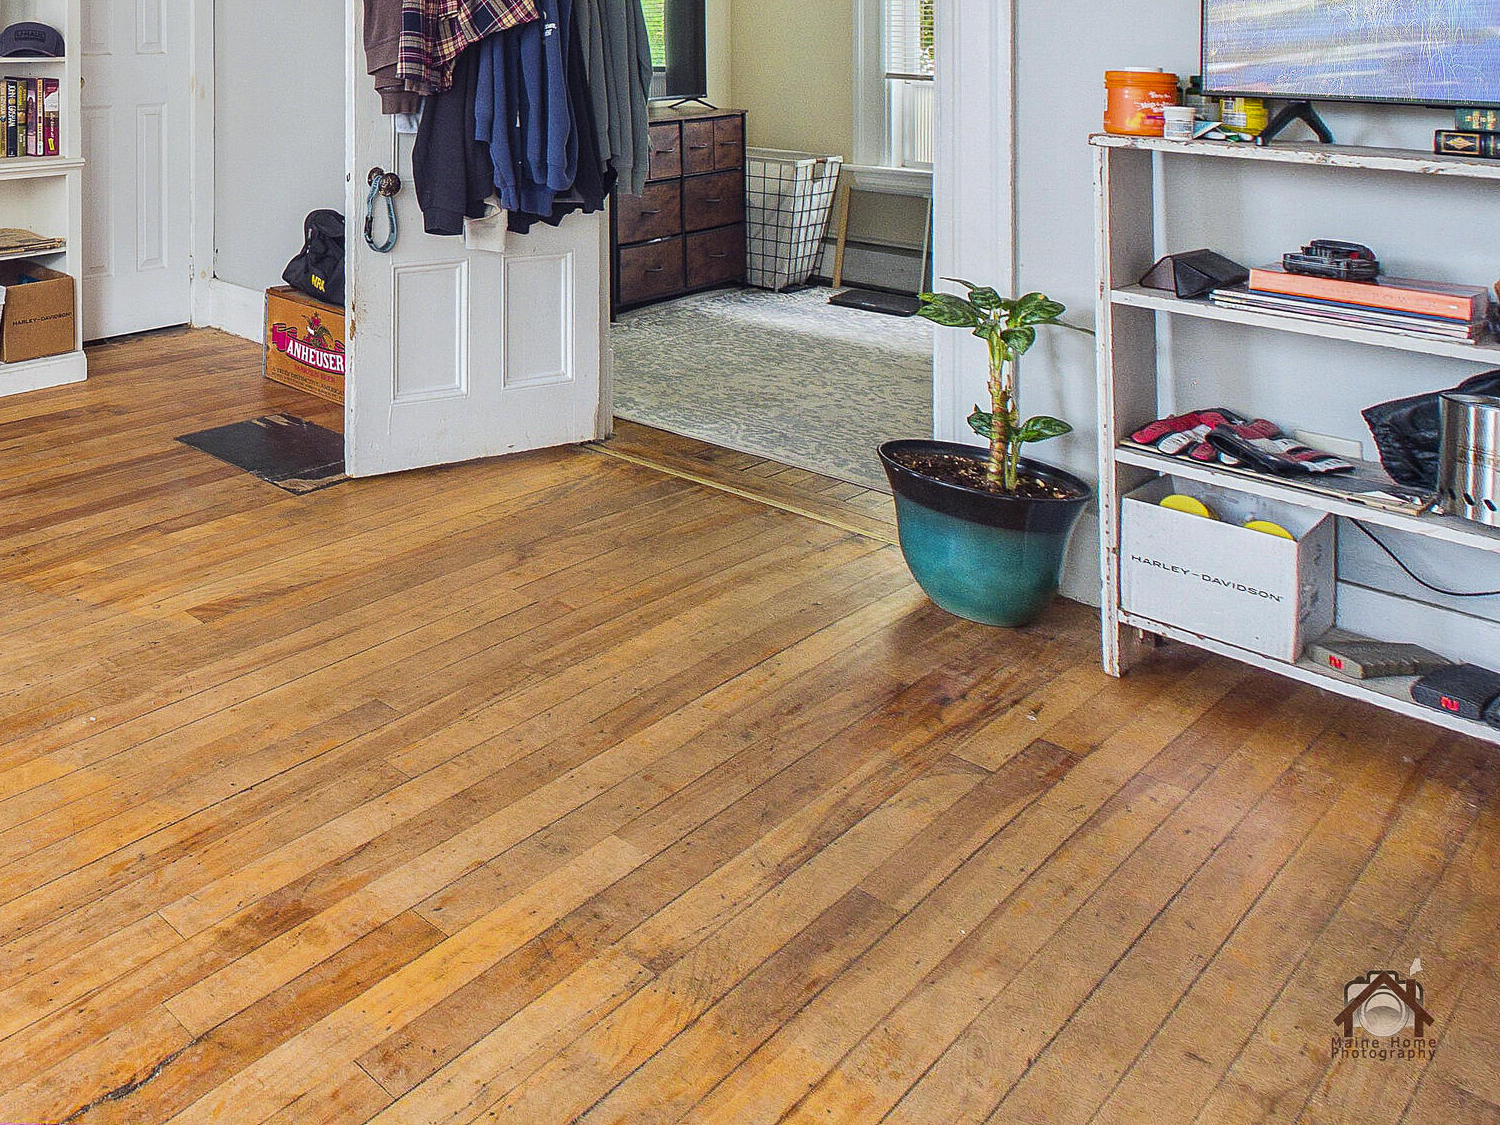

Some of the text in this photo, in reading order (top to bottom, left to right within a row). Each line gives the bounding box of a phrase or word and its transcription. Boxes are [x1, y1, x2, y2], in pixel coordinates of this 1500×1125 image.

[12, 312, 72, 327] HARLEY-DAVIDSON
[286, 339, 345, 374] ANHEUSER
[1131, 554, 1282, 603] HARLEY-DAVIDSON
